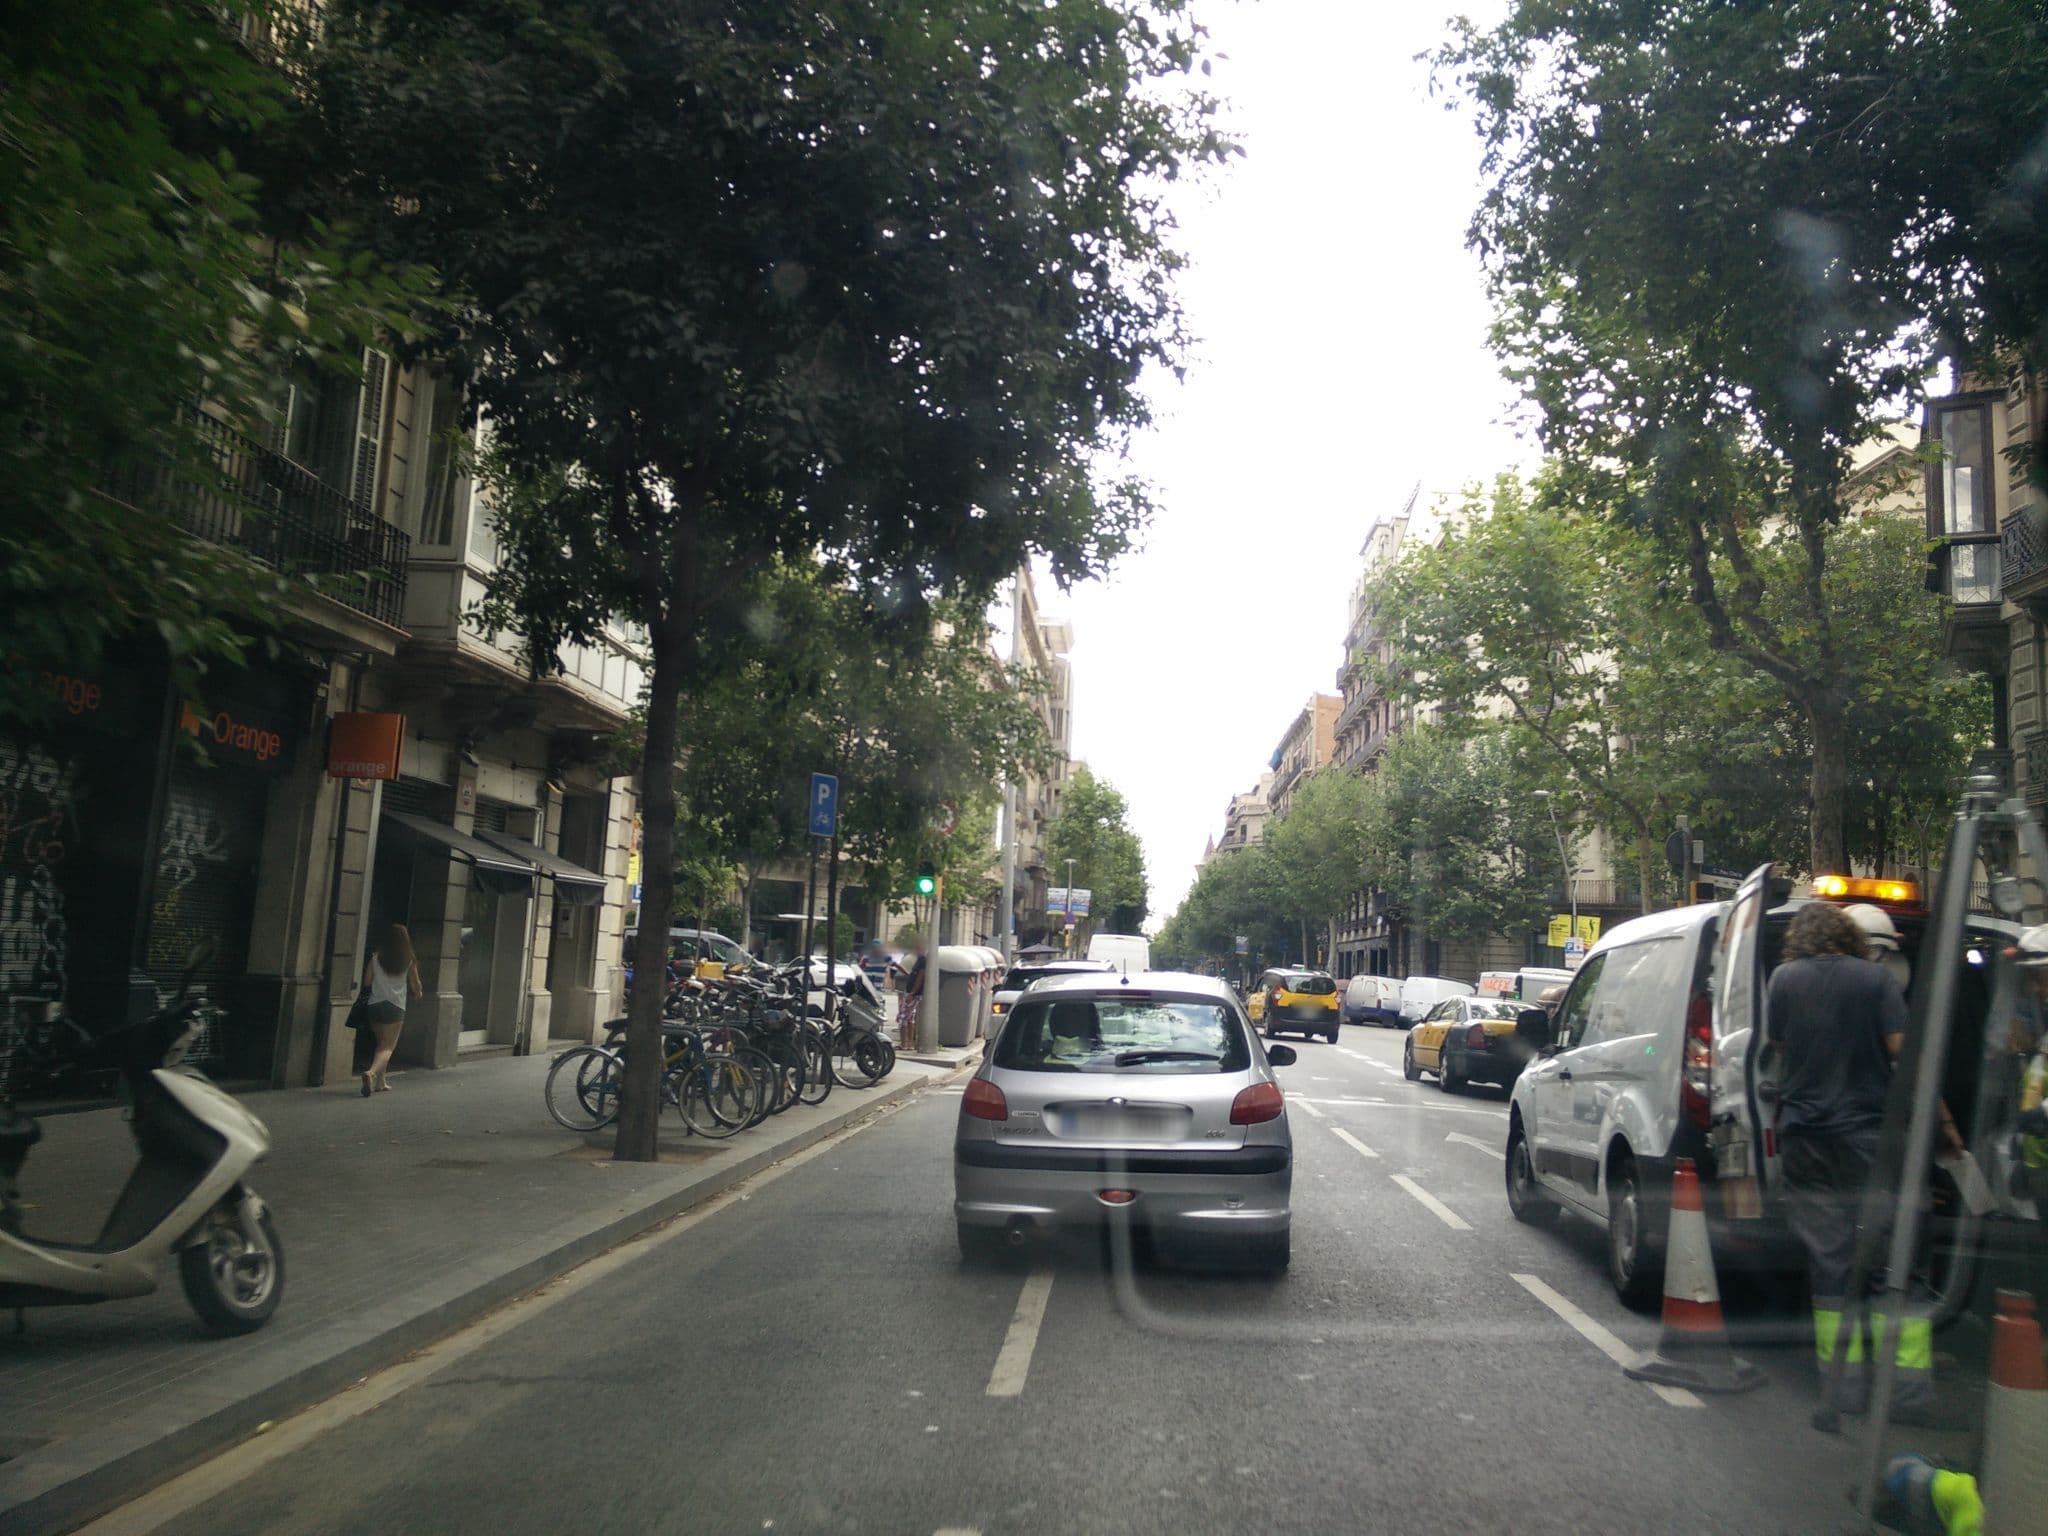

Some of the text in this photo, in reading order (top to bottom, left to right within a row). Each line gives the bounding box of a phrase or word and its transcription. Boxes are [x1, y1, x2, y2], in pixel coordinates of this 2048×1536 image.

[214, 712, 281, 760] Orange
[330, 760, 386, 777] orange
[818, 783, 831, 805] P
